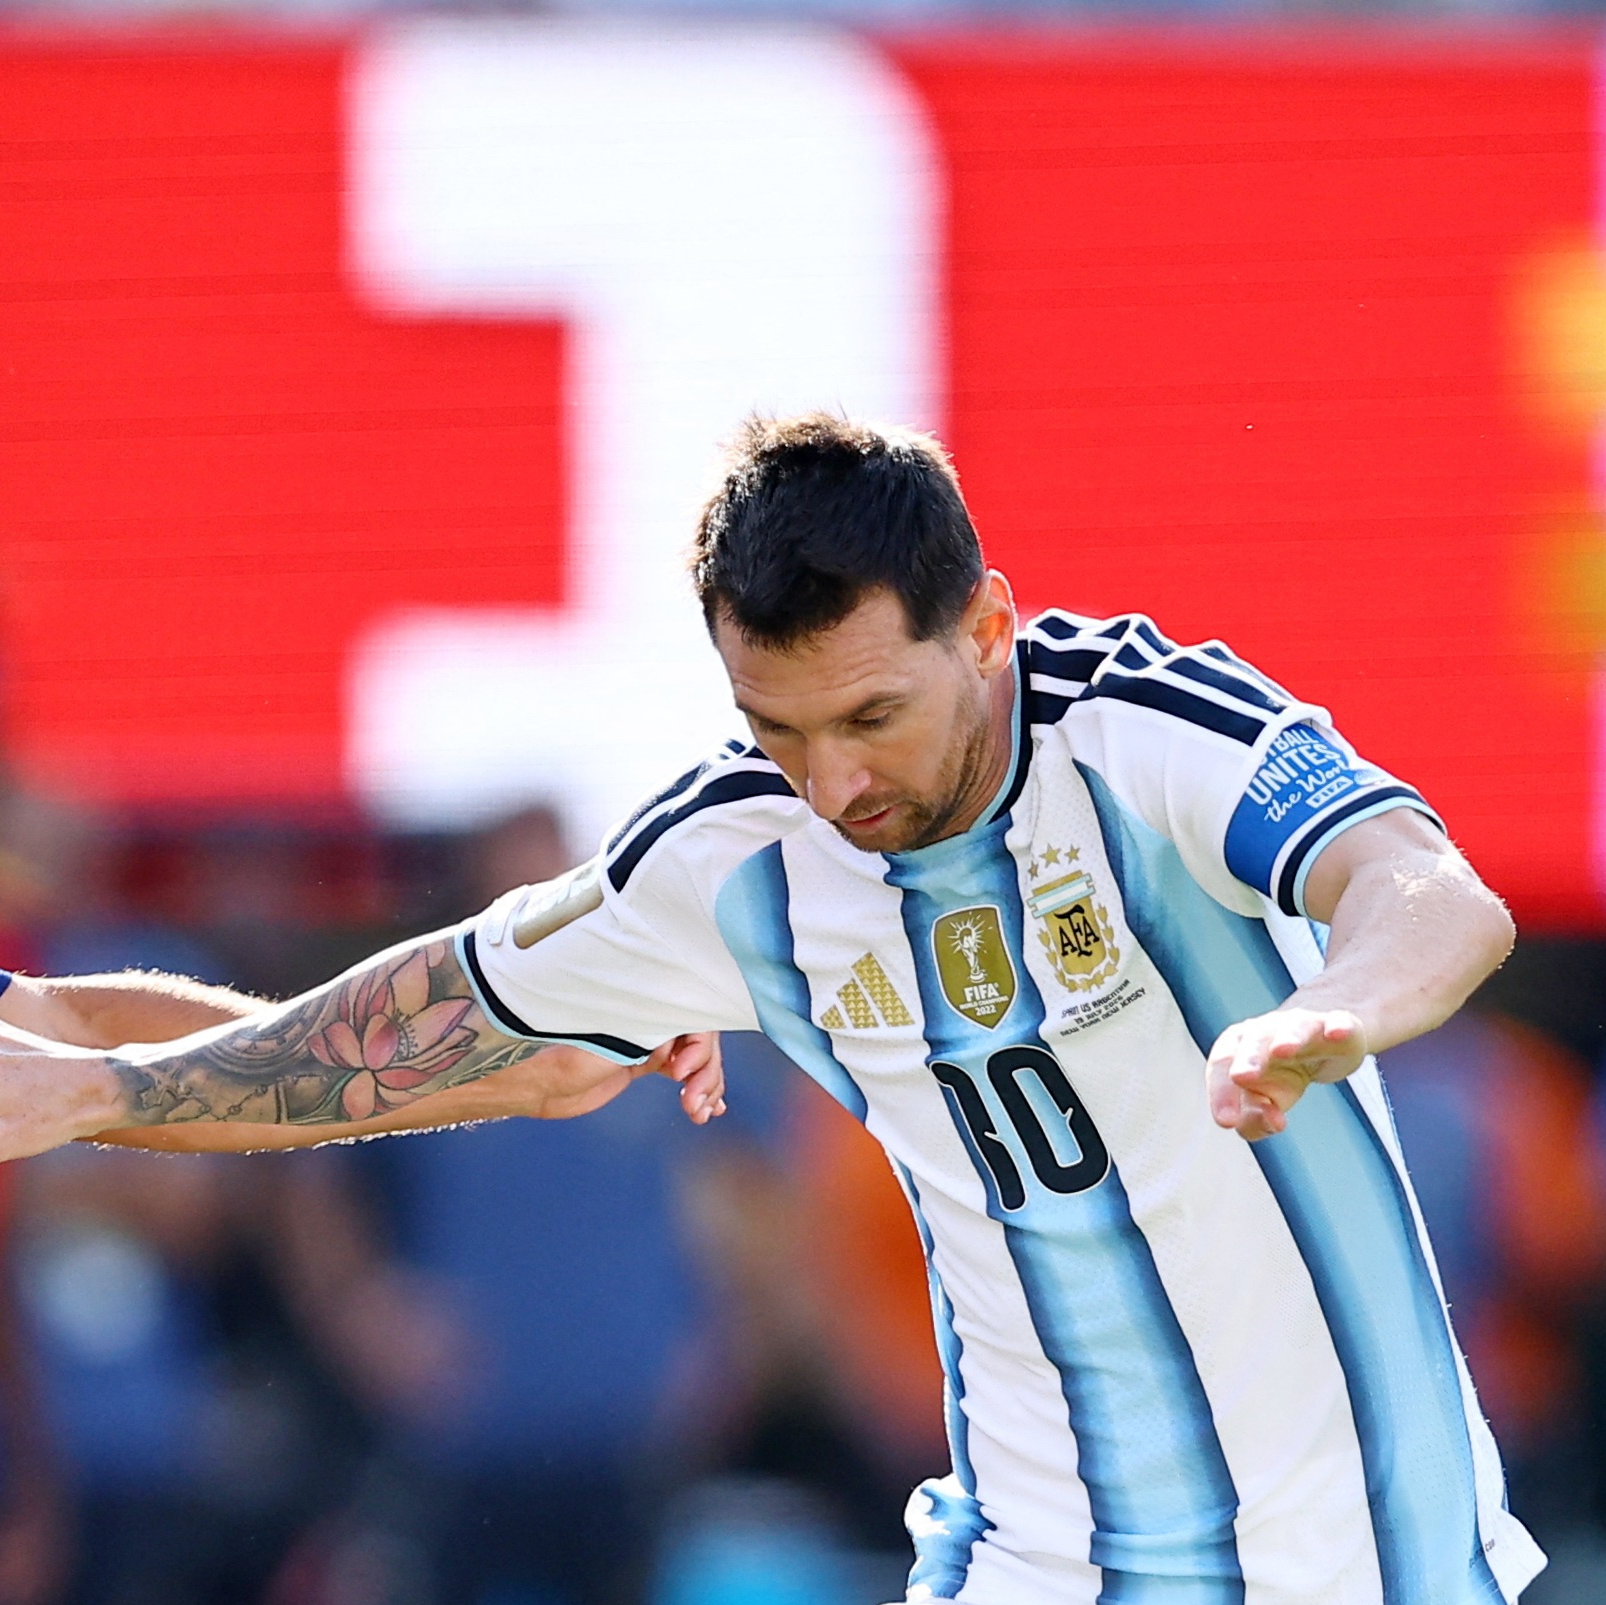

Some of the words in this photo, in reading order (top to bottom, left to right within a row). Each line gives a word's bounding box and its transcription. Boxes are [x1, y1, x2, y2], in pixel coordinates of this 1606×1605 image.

[343, 22, 949, 850] 1
[1246, 743, 1341, 806] UNITES
[1263, 791, 1302, 823] the
[1310, 779, 1350, 805] FIFA
[1054, 904, 1100, 957] AFA
[964, 983, 1000, 1002] FIFA
[1120, 987, 1146, 1008] JERSEY
[975, 1004, 997, 1016] 2022
[929, 1045, 1112, 1214] 10
